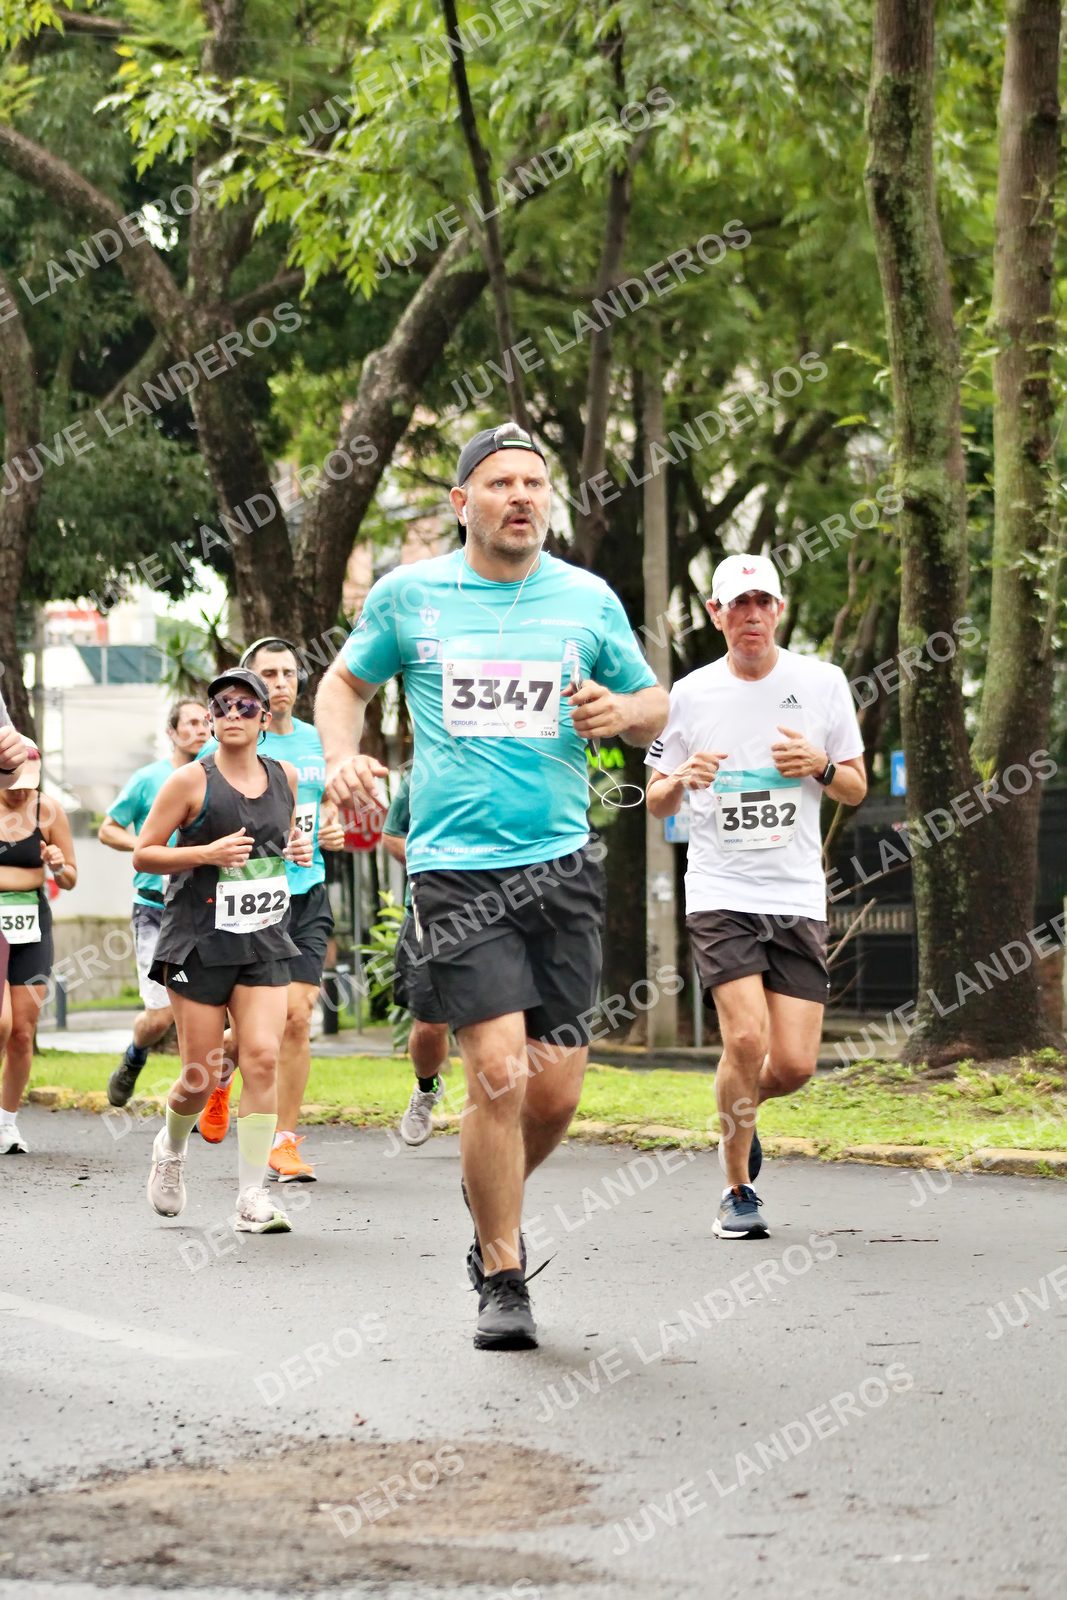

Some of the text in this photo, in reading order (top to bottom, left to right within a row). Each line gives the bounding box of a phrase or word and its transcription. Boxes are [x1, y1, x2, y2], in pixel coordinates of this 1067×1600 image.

[451, 679, 554, 711] 3347
[722, 803, 796, 831] 3582
[224, 890, 286, 917] 1822
[2, 915, 35, 930] 387
